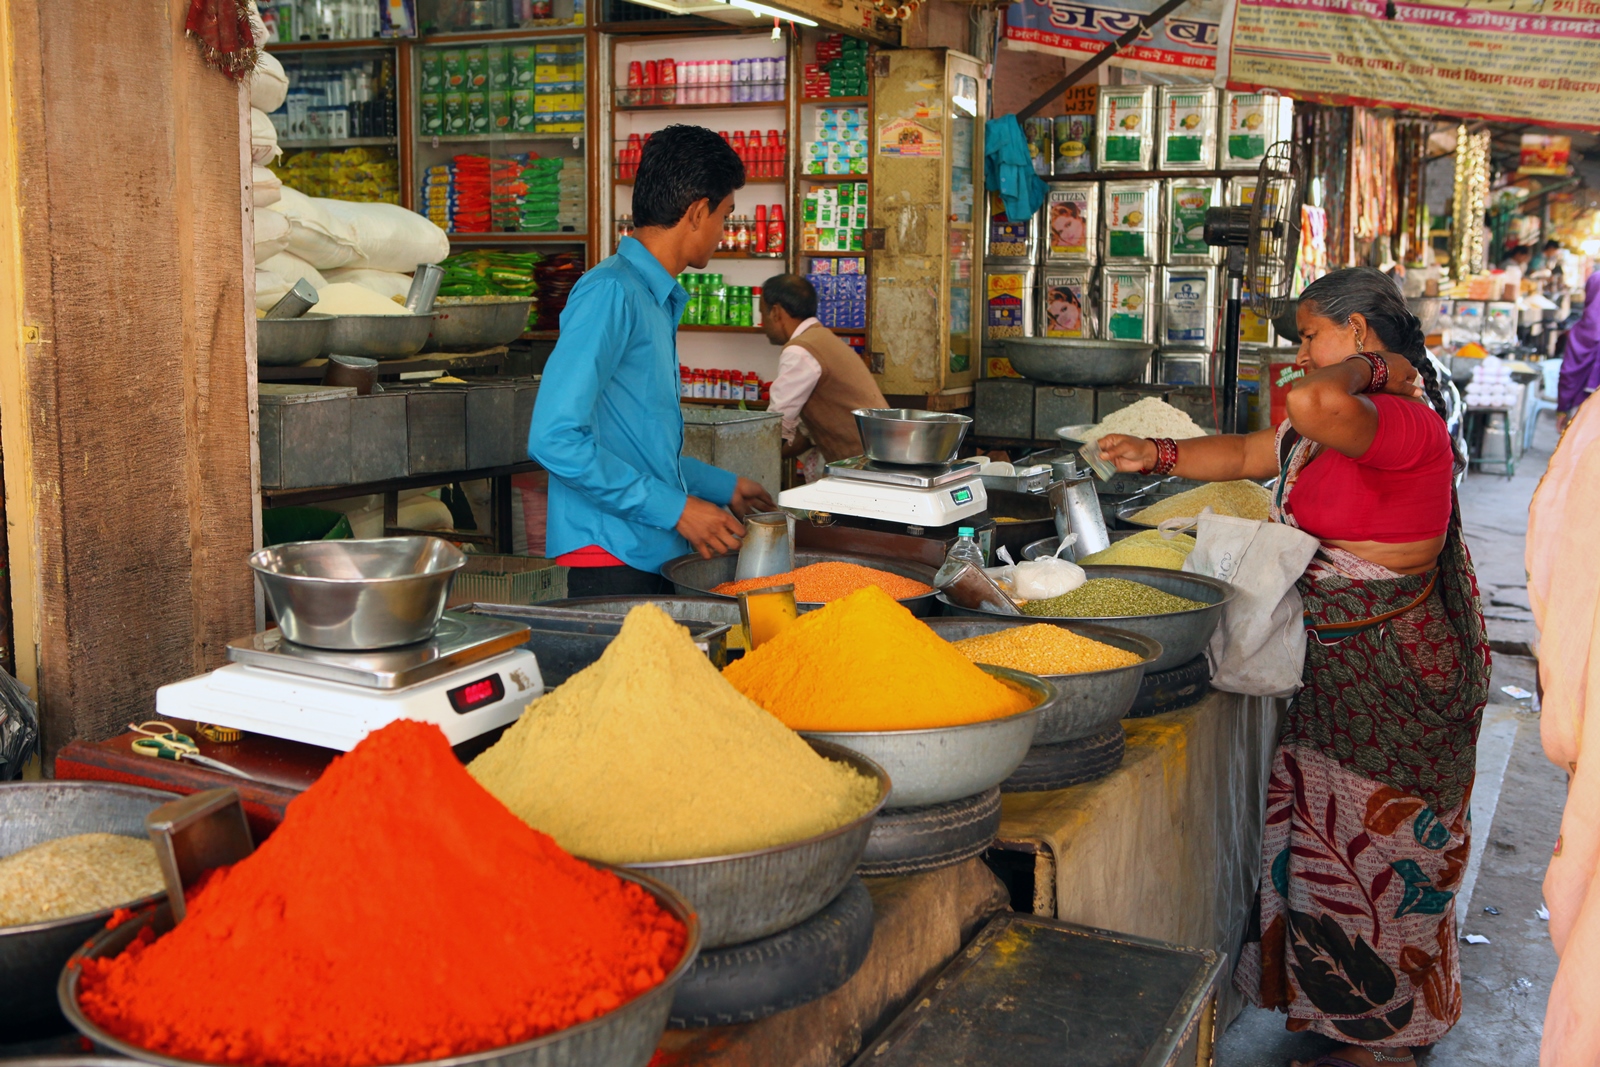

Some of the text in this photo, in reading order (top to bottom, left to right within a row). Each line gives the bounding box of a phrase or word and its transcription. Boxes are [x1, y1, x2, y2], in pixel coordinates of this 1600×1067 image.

[1067, 87, 1095, 99] JMC
[1065, 100, 1094, 112] W37
[1051, 192, 1086, 201] CITIZEN
[1047, 277, 1081, 286] CITIZEN
